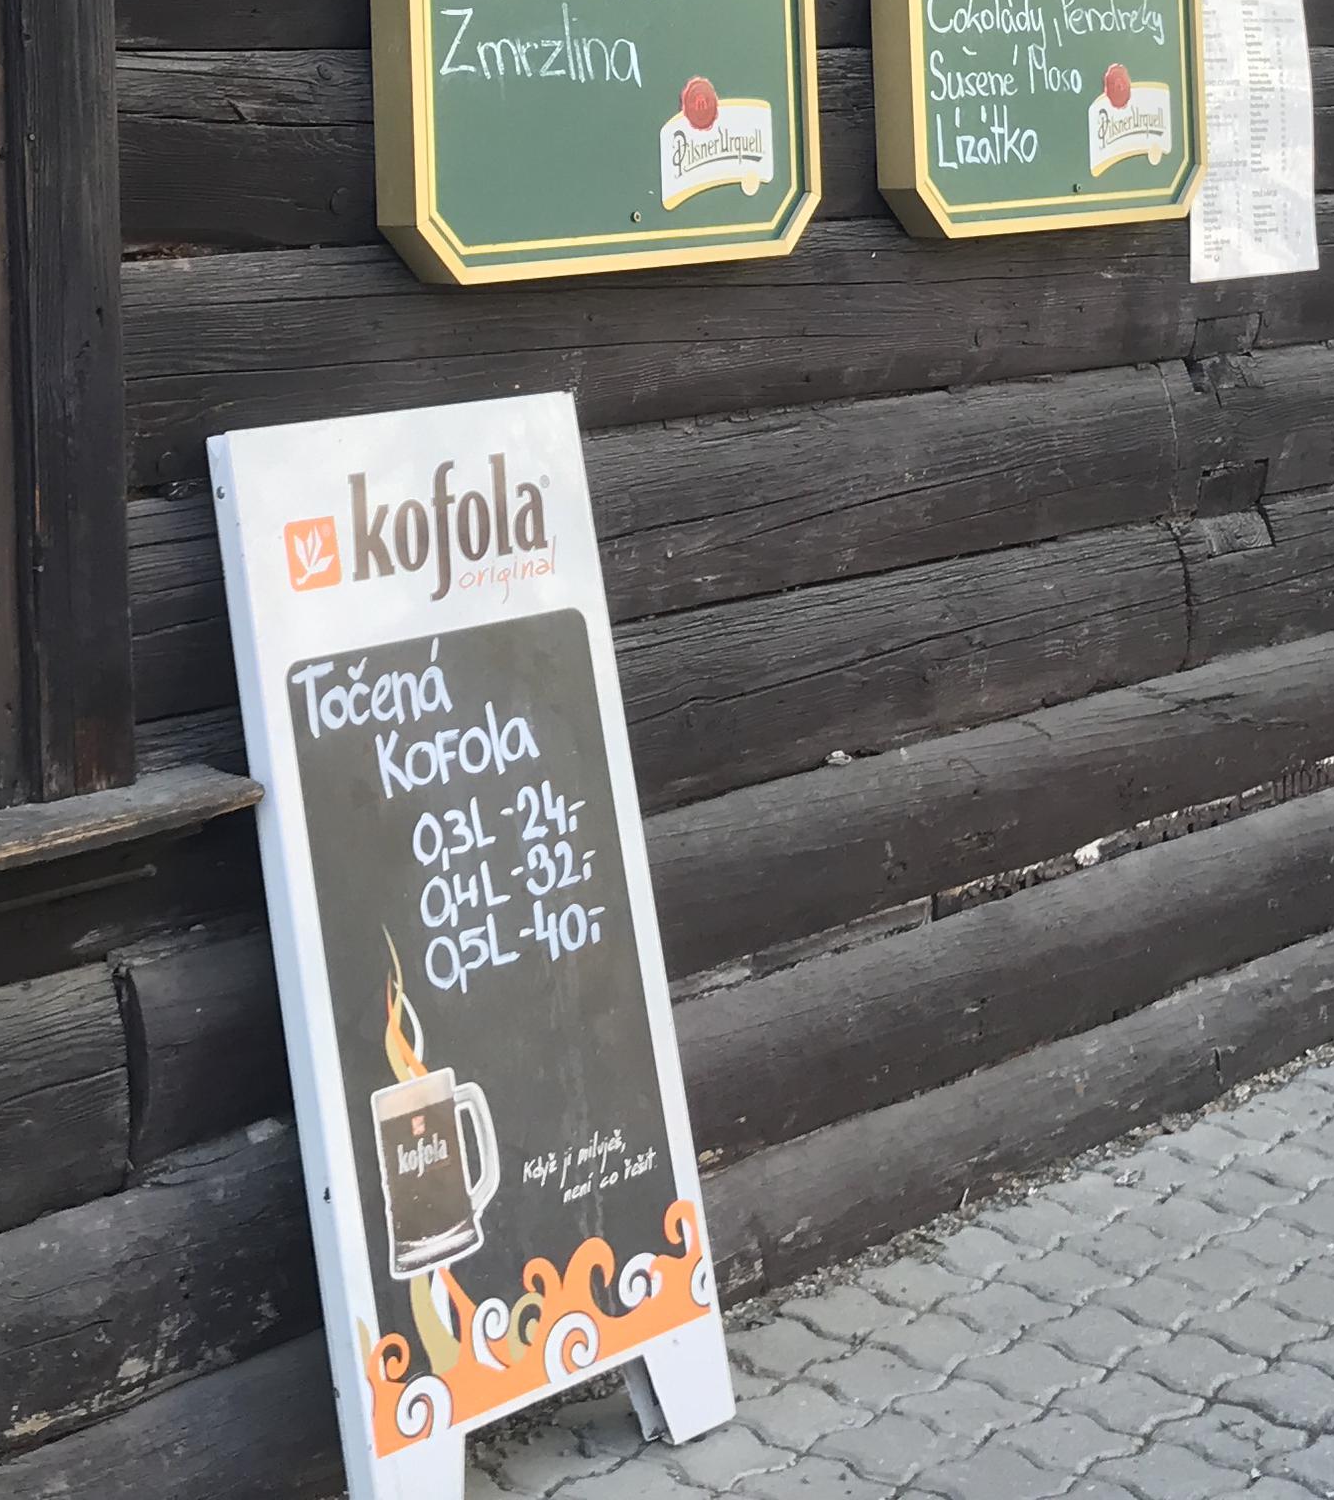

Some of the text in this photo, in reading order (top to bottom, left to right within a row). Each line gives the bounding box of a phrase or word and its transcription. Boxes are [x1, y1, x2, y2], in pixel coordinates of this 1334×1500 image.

[439, 2, 643, 89] Zmrzlina
[929, 43, 1020, 102] Sušené
[671, 126, 764, 180] Pilsner Urquell
[935, 104, 1040, 169] Lízátko
[1097, 107, 1134, 150] Pilsner
[1130, 105, 1165, 139] Urquell
[347, 451, 549, 603] kofola
[458, 534, 557, 604] original
[290, 636, 454, 739] Točená
[411, 795, 497, 872] 0,3L
[419, 859, 512, 930] 0,4L
[424, 913, 521, 995] 0,5L
[396, 1131, 450, 1179] kofola
[522, 1151, 559, 1188] Když
[558, 1145, 575, 1190] ji
[562, 1171, 596, 1205] není
[598, 1170, 621, 1190] co
